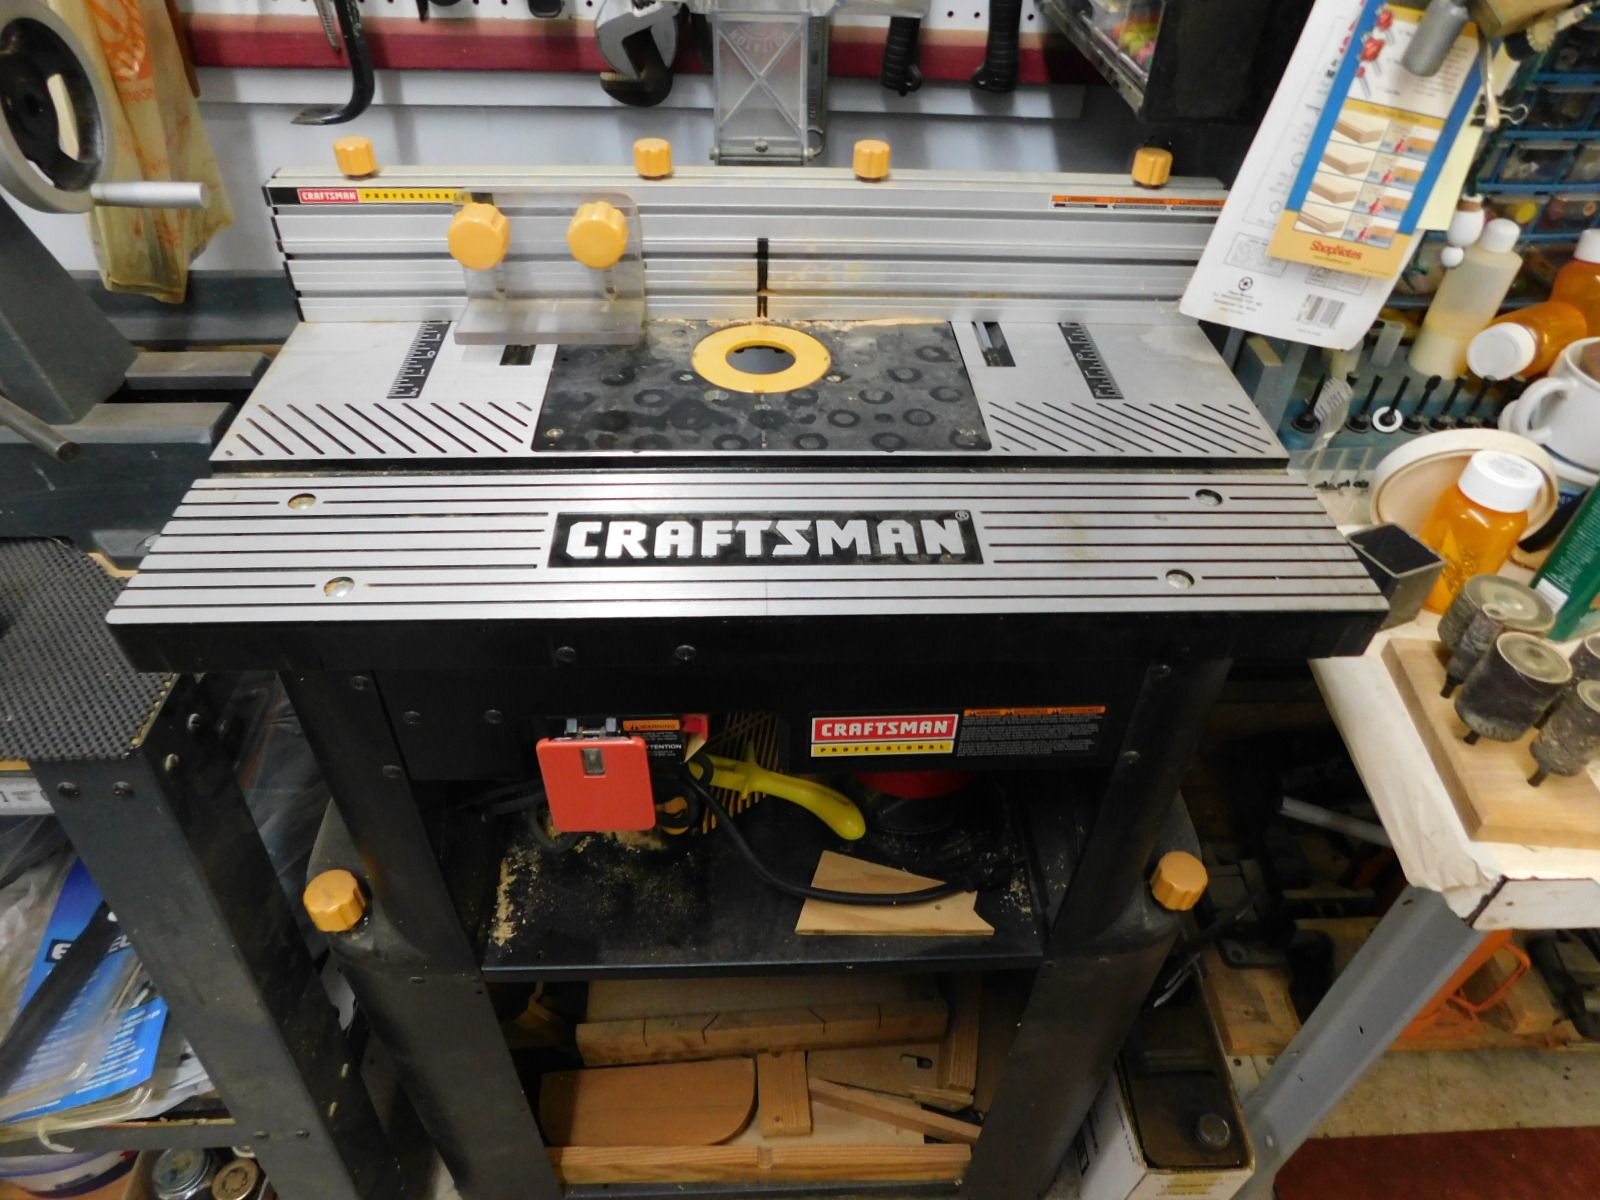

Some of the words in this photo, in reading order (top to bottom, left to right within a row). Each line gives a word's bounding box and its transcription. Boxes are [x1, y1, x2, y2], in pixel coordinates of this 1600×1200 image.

[301, 190, 356, 201] CRAFTSMAN
[1310, 240, 1363, 260] ShopNotes
[565, 519, 966, 559] CRAFTSMAN
[821, 720, 949, 737] CRAFTSMAN
[820, 744, 944, 753] PROFESSIONAL
